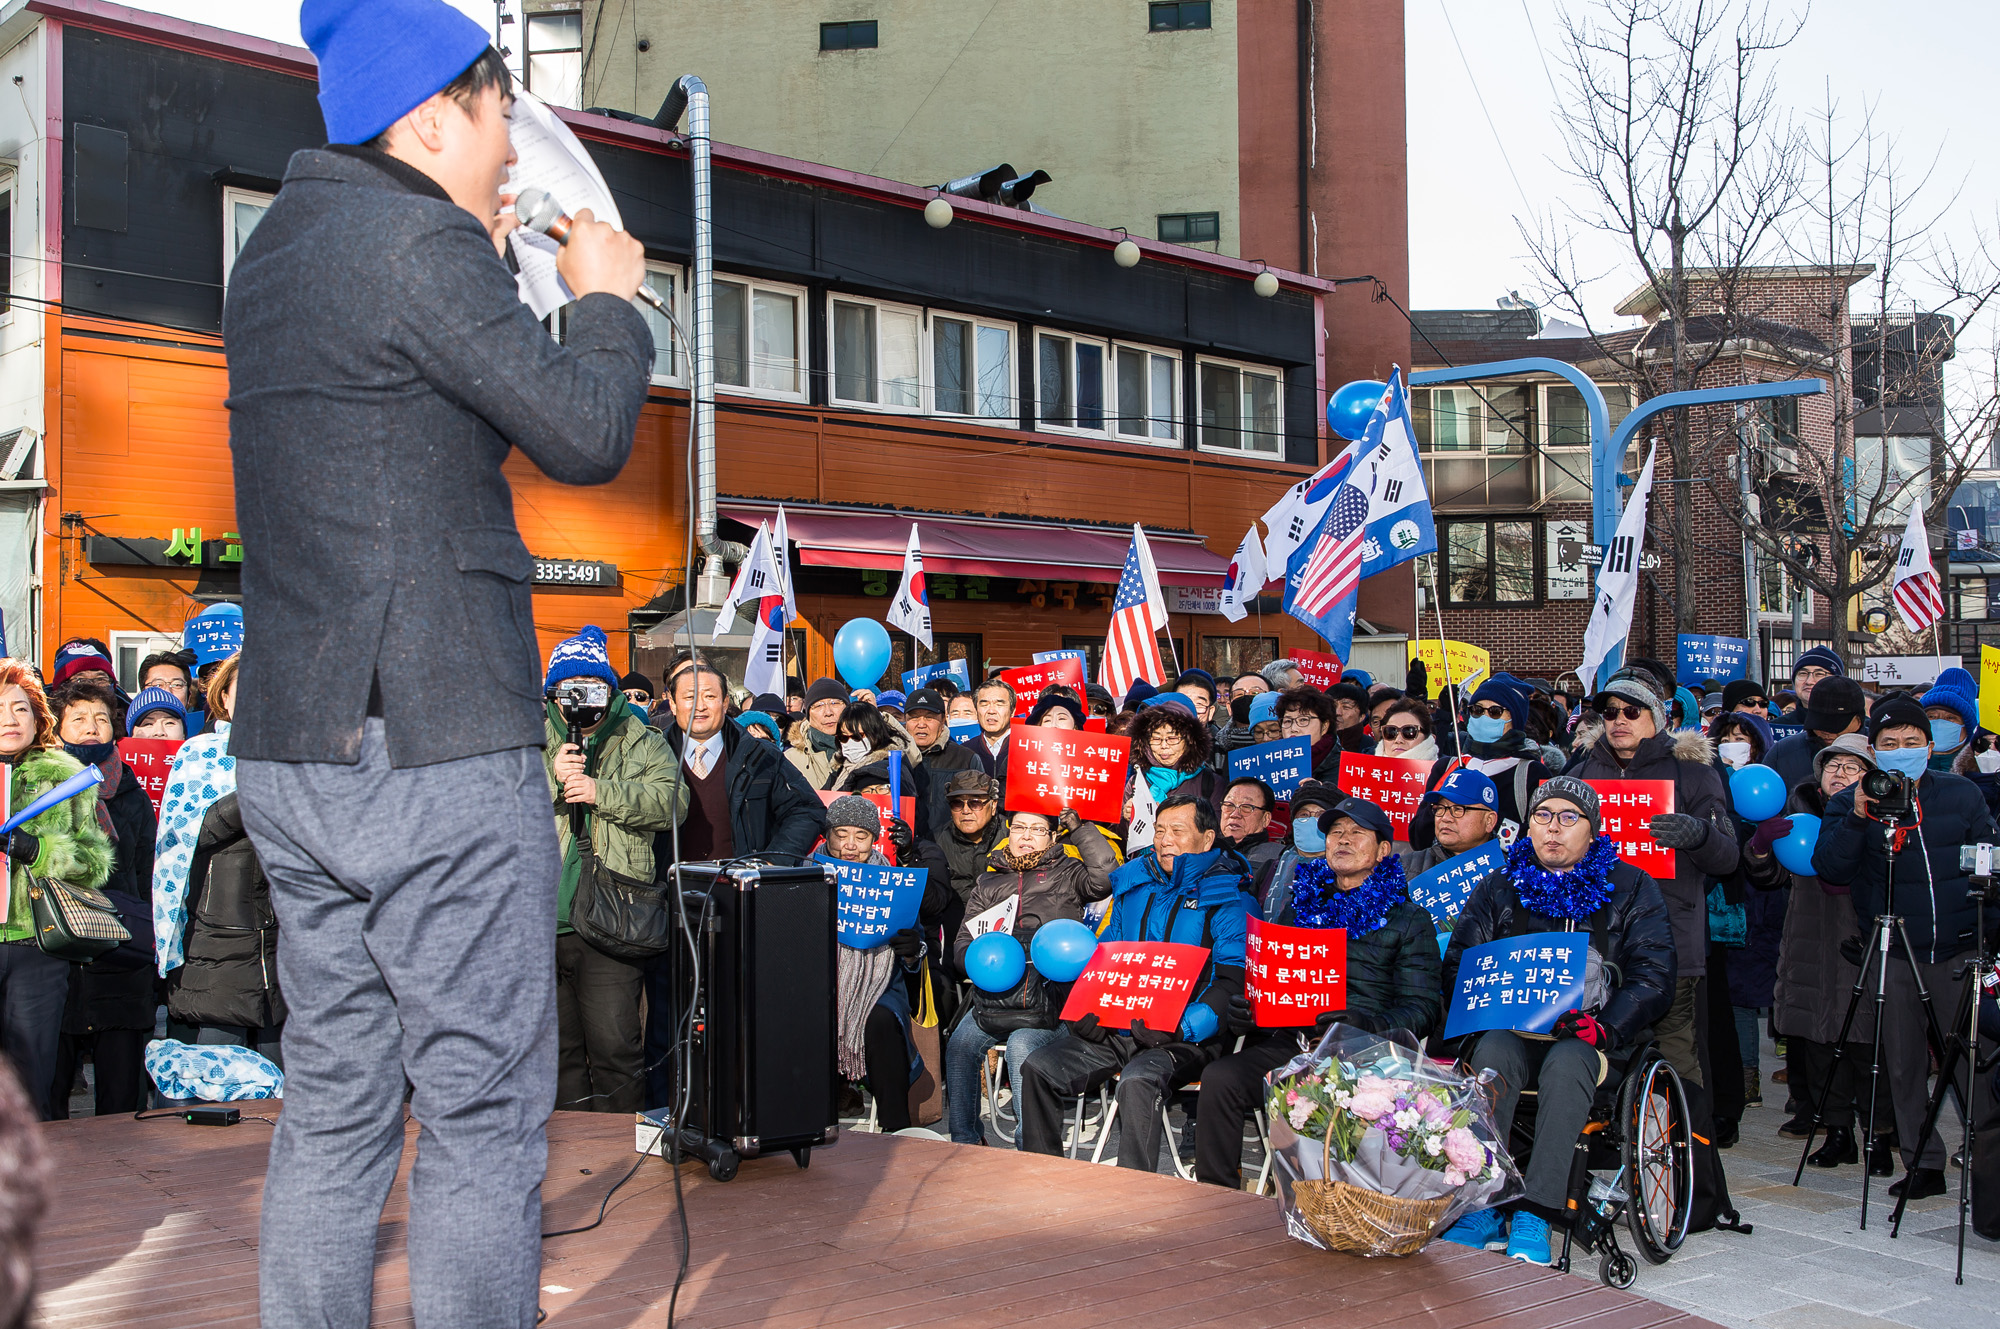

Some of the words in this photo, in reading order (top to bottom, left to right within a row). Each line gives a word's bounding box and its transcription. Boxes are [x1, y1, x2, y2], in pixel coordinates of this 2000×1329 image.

[536, 563, 601, 582] 335-5491
[192, 620, 225, 630] 이땅이
[197, 632, 232, 643] 김정은
[1683, 641, 1707, 650] 이땅이
[1713, 642, 1743, 652] 어디라고
[1687, 653, 1711, 663] 김정은
[1716, 654, 1739, 665] 맘대로
[1017, 673, 1042, 686] 비핵화
[1047, 669, 1065, 681] 없는
[1693, 666, 1731, 677] 오고가냐?
[1866, 662, 1898, 679] 탄츄
[125, 753, 155, 765] 니가
[1018, 739, 1044, 752] 니가
[1051, 742, 1076, 757] 죽인
[1084, 746, 1122, 762] 수백만
[1234, 758, 1260, 771] 이땅이
[1265, 747, 1304, 764] 어디라고
[1026, 761, 1051, 776] 원혼
[1060, 764, 1110, 782] 김정은을
[1270, 767, 1299, 784] 맘대로
[1345, 765, 1365, 778] 니가
[1370, 768, 1394, 783] 죽인
[1351, 786, 1372, 800] 원혼
[1598, 794, 1653, 806] 우리나라
[1437, 854, 1490, 885] 지지폭락
[879, 871, 916, 887] 김정은
[840, 884, 894, 902] 제거하여
[838, 901, 891, 919] 나라답게
[837, 918, 889, 936] 살아보자
[1267, 941, 1329, 960] 자영업자
[1509, 947, 1572, 964] 지지폭락
[1110, 952, 1147, 964] 비핵화
[1152, 953, 1177, 969] 없는
[1083, 969, 1133, 987] 사기방남
[1138, 974, 1189, 991] 전국민이
[1275, 967, 1341, 984] 문재인은
[1463, 971, 1514, 993] 건져주는
[1525, 968, 1574, 985] 김정은
[1099, 992, 1153, 1010] 분노한다!
[1466, 994, 1491, 1011] 같은
[1500, 988, 1560, 1005] 편인가?
